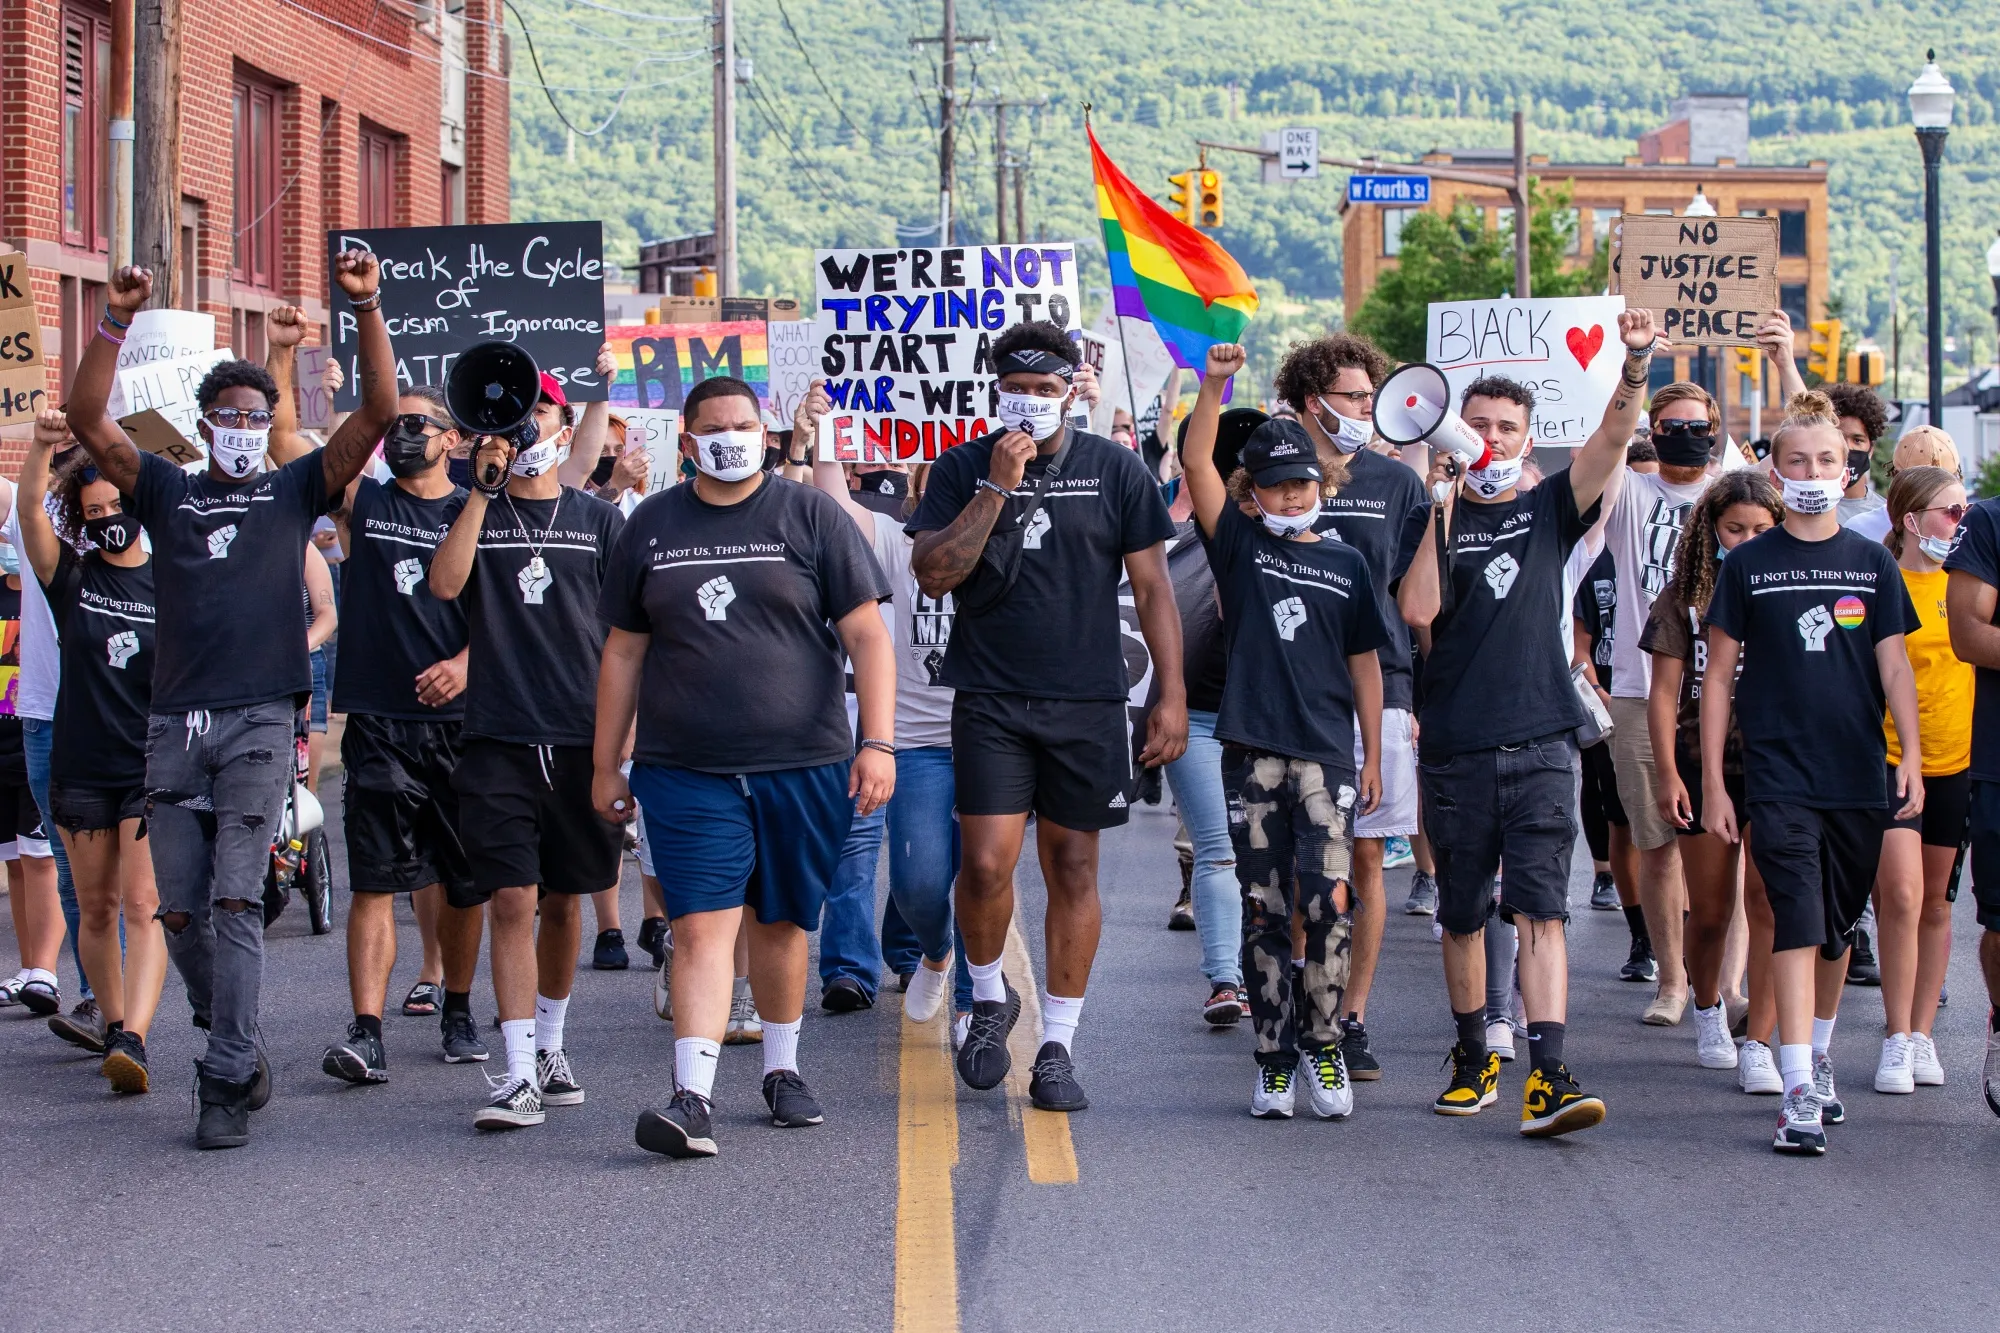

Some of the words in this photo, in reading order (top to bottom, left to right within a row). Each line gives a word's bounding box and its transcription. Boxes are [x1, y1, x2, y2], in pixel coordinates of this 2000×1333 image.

[1286, 131, 1312, 143] ONE
[1286, 146, 1312, 157] WAY
[1365, 179, 1411, 199] Fourth
[1679, 221, 1719, 245] NO
[466, 243, 515, 280] the
[522, 236, 604, 287] Cycle
[821, 248, 965, 292] WE'RE
[981, 246, 1073, 288] NOT
[1640, 253, 1759, 280] JUSTICE
[436, 276, 480, 309] of
[1677, 281, 1718, 305] NO
[822, 288, 1006, 334] TRYING
[1015, 292, 1071, 330] TO
[338, 311, 450, 344] Rcism
[478, 310, 603, 343] Ignorance
[772, 323, 817, 343] WHAT
[1664, 308, 1759, 338] PEACE
[821, 332, 956, 377] START
[132, 373, 177, 412] ALL
[720, 445, 747, 454] STRONG
[722, 452, 743, 461] BLACK
[1269, 447, 1300, 457] BREATHE
[1274, 443, 1294, 451] CAN'T
[1033, 479, 1064, 488] TEN
[1066, 478, 1100, 488] WHO?
[1326, 497, 1354, 507] THEN
[1356, 499, 1386, 509] WHO?
[101, 524, 126, 549] XO
[375, 520, 397, 532] NOT
[411, 528, 439, 541] THEN
[486, 529, 510, 539] NOT
[532, 528, 563, 539] THEN
[565, 530, 597, 543] WHO?
[654, 552, 664, 561] IF
[666, 548, 691, 559] NOT
[693, 547, 711, 557] US,
[714, 544, 747, 555] THEN
[749, 542, 786, 553] WHO?
[1291, 563, 1321, 577] THEN
[1322, 569, 1352, 588] WHO?
[1750, 575, 1761, 585] IF
[1763, 571, 1789, 582] NOT
[1791, 570, 1809, 580] US,
[1810, 569, 1842, 580] THEN
[1844, 571, 1877, 583] WHO?
[122, 601, 150, 614] THEN
[1834, 608, 1853, 616] DISARM
